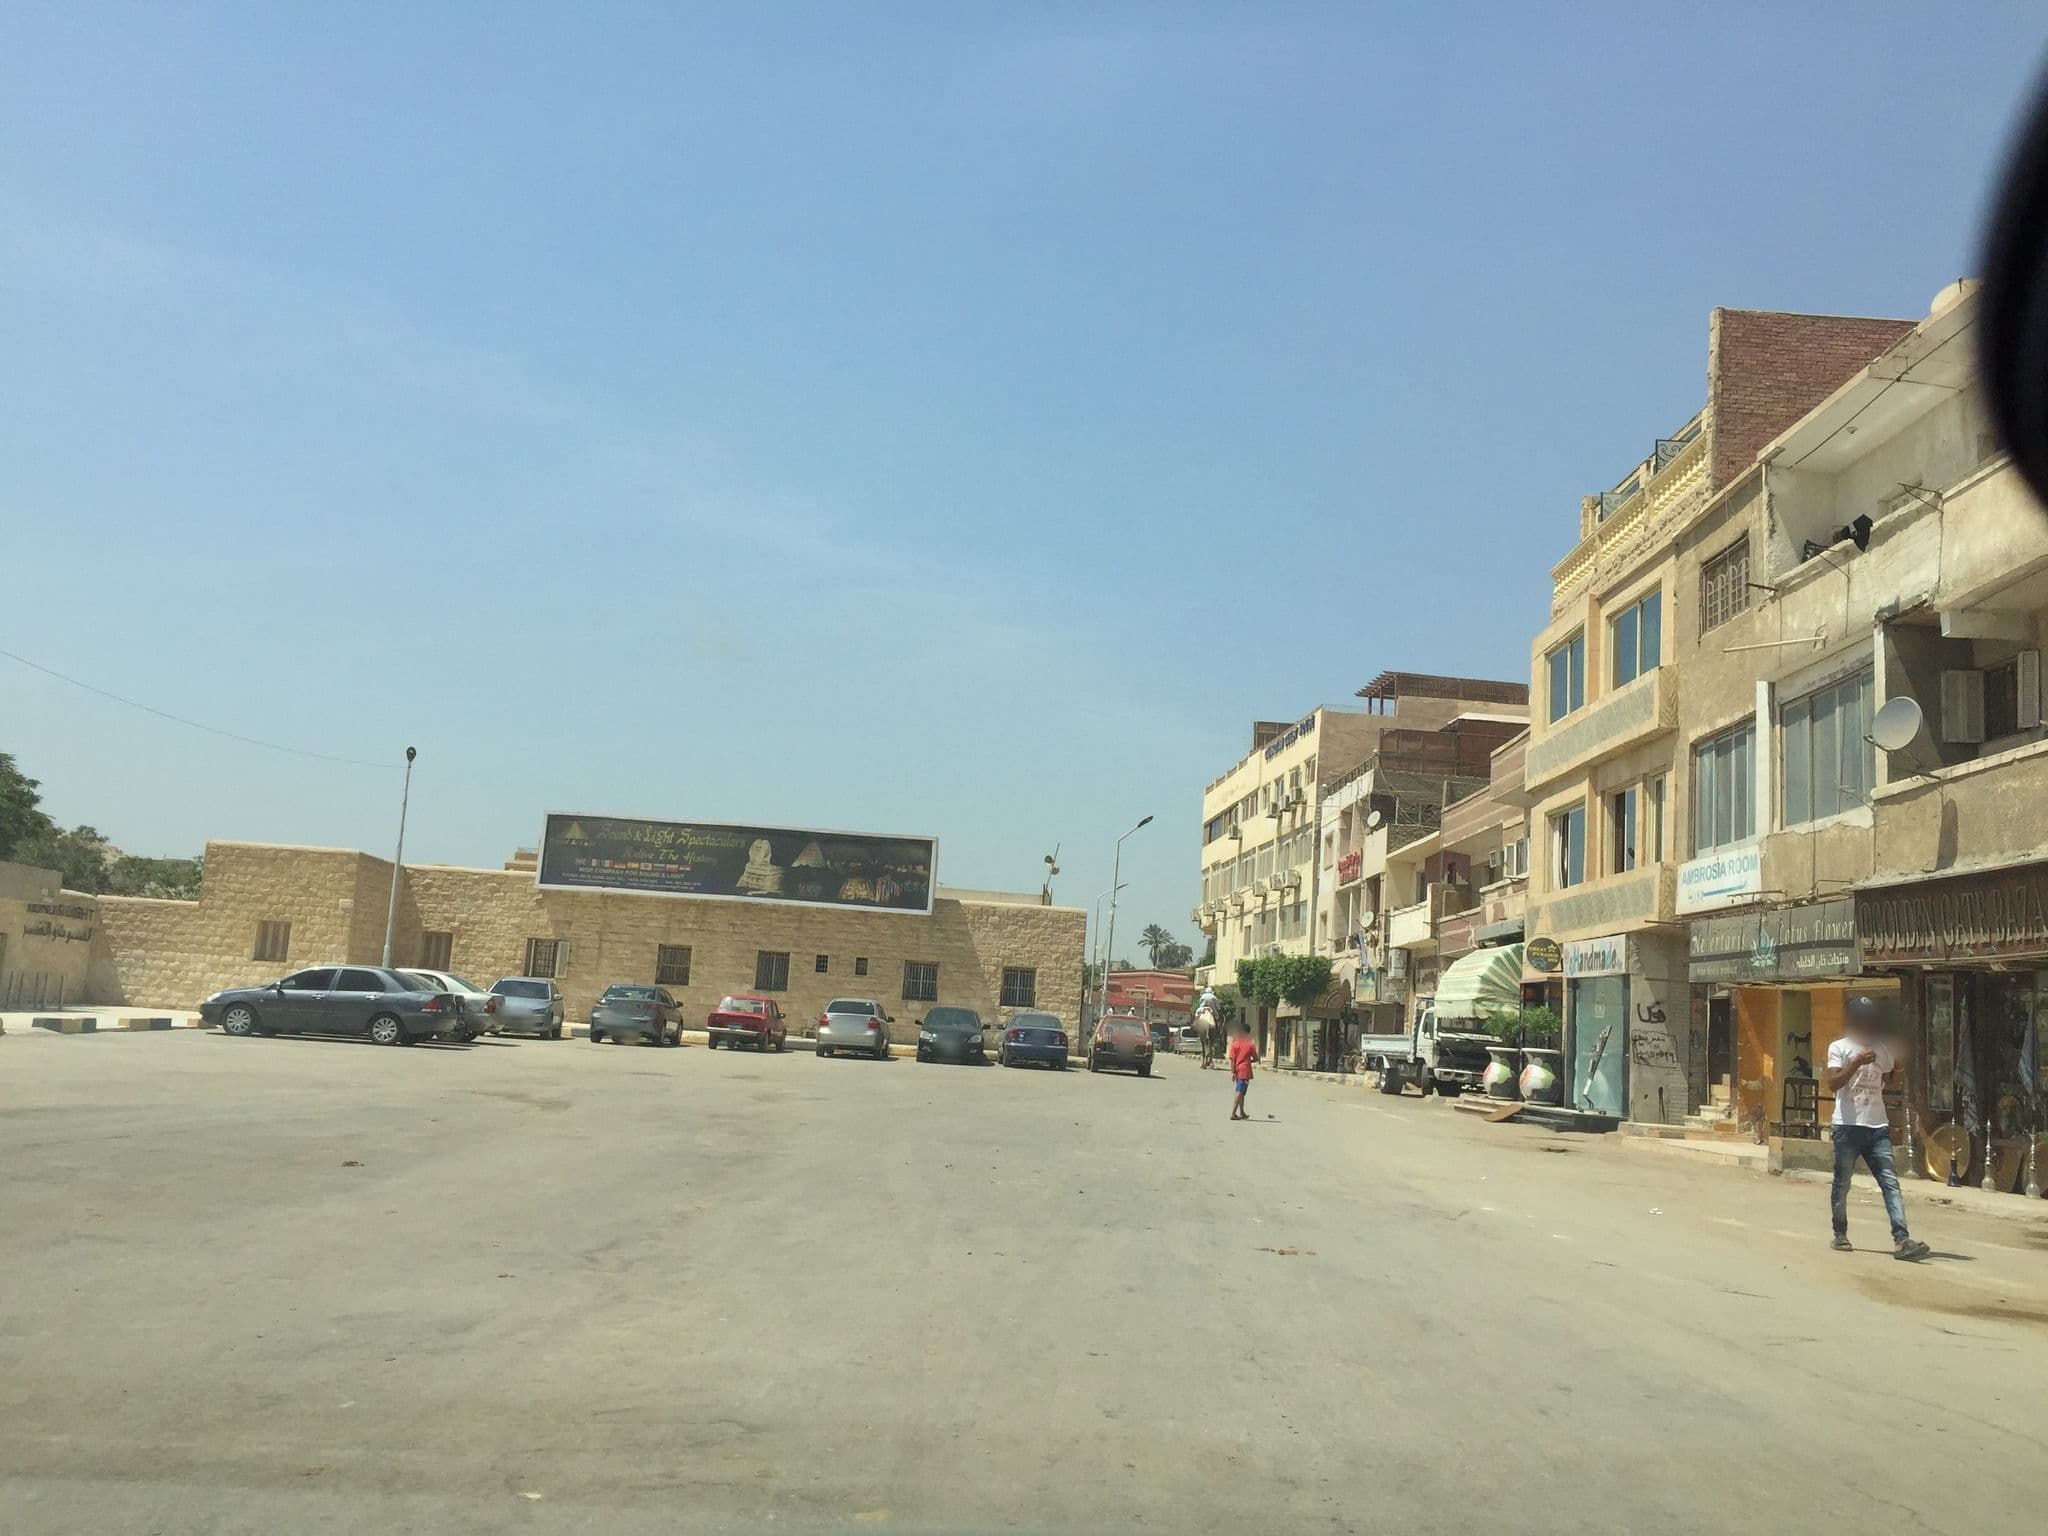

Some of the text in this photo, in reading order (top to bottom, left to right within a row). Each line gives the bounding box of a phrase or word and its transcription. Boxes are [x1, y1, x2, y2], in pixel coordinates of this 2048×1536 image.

[643, 824, 674, 847] Light
[658, 848, 679, 861] The
[1682, 854, 1758, 885] AMBROSIA ROOM
[1778, 922, 1808, 946] Lotus
[1815, 918, 1855, 943] Flower
[1573, 943, 1617, 973] Handmade
